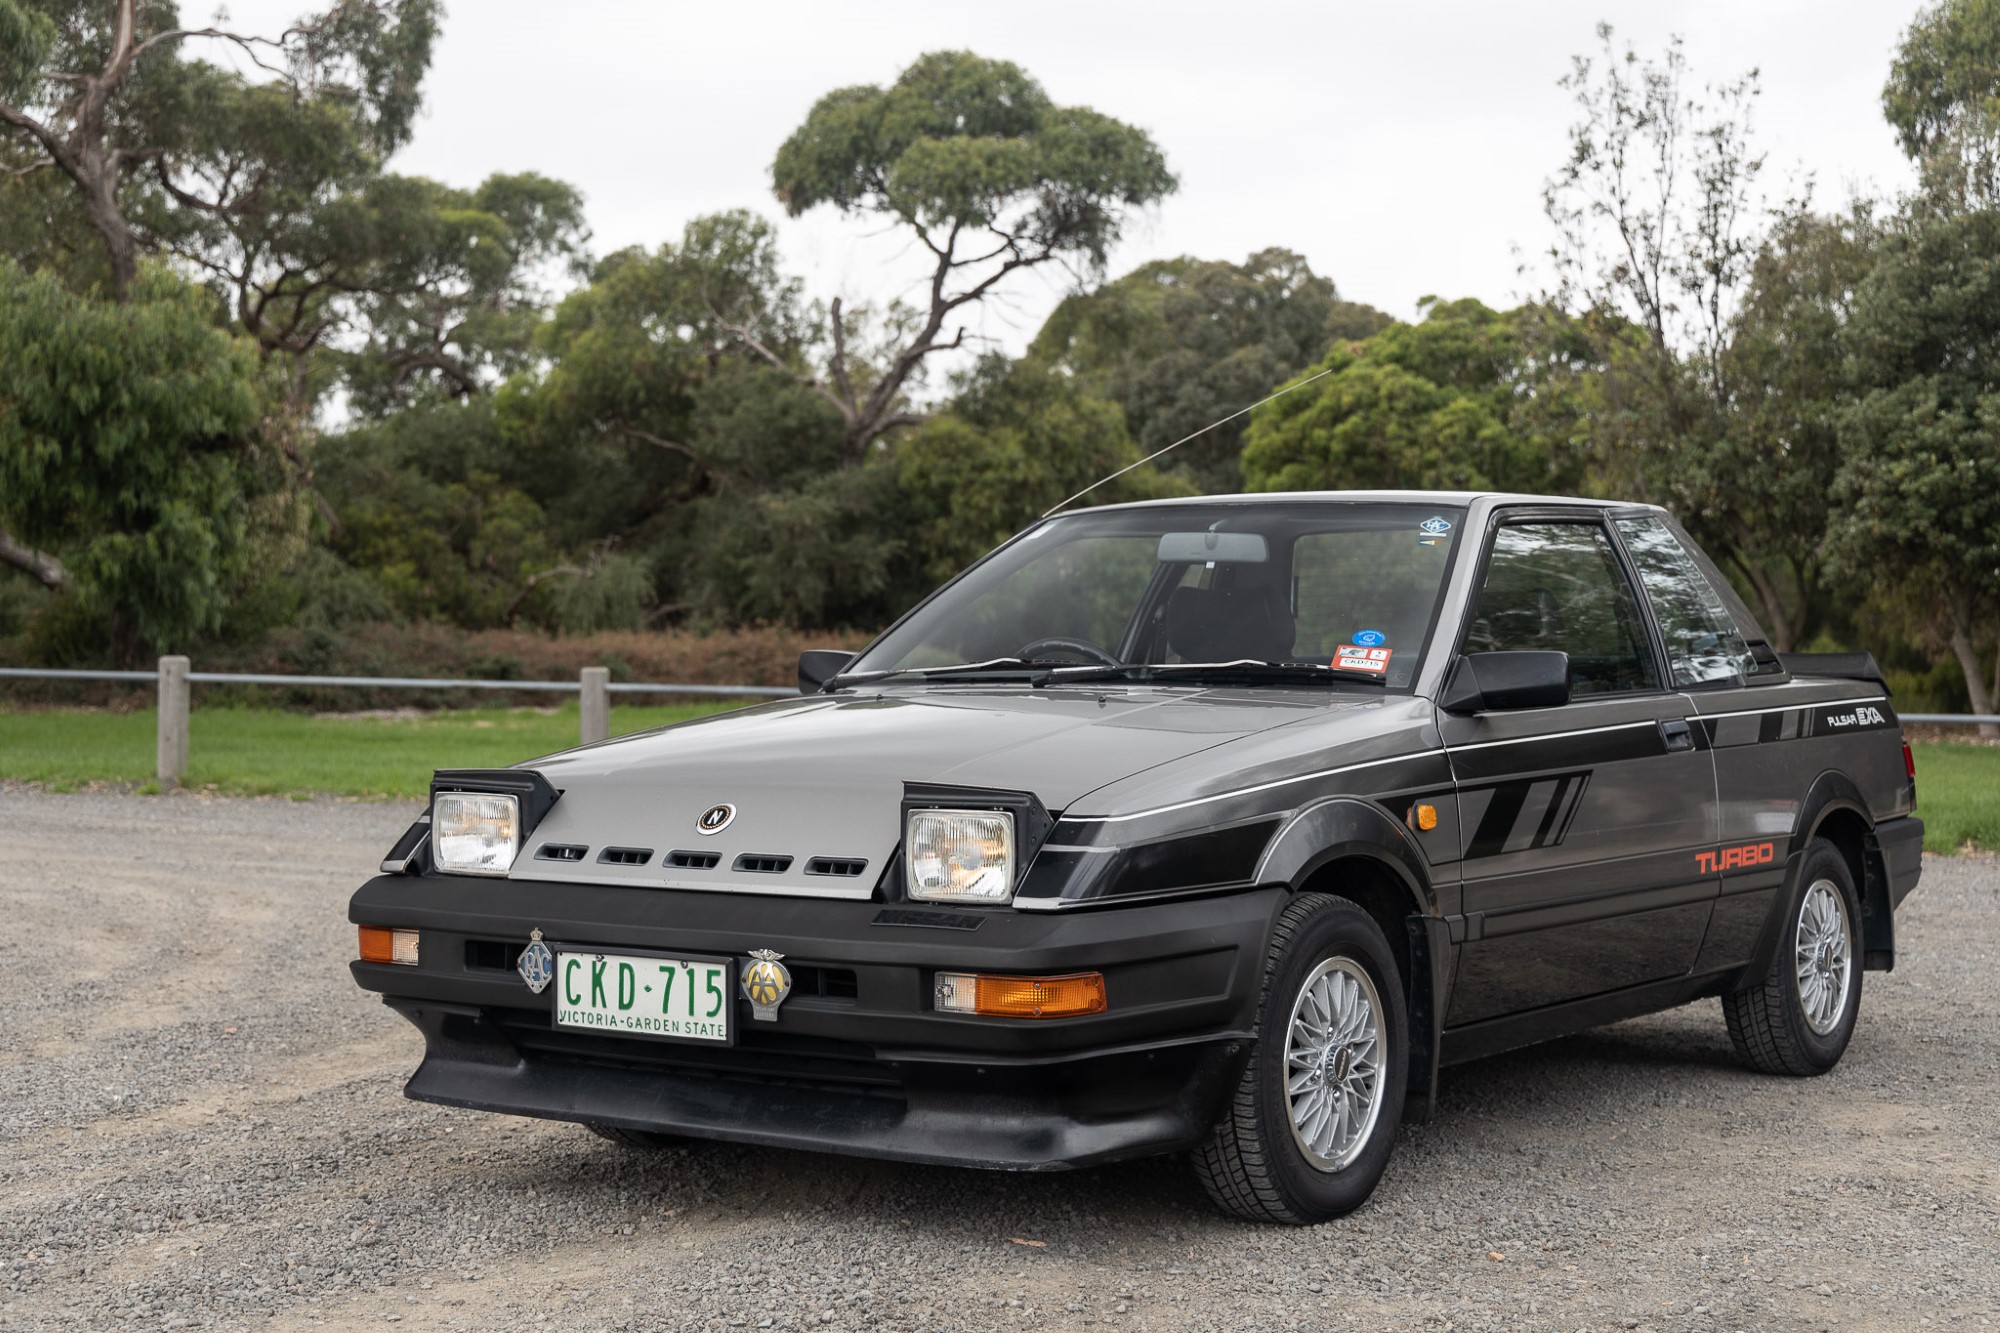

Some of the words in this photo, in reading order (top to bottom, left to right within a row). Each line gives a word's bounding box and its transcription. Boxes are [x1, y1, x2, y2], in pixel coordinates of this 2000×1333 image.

[1827, 714, 1857, 727] PULSAR
[1855, 707, 1885, 726] EXA
[1695, 842, 1774, 874] TURBO
[524, 945, 553, 983] RAC
[684, 1022, 724, 1037] STATE
